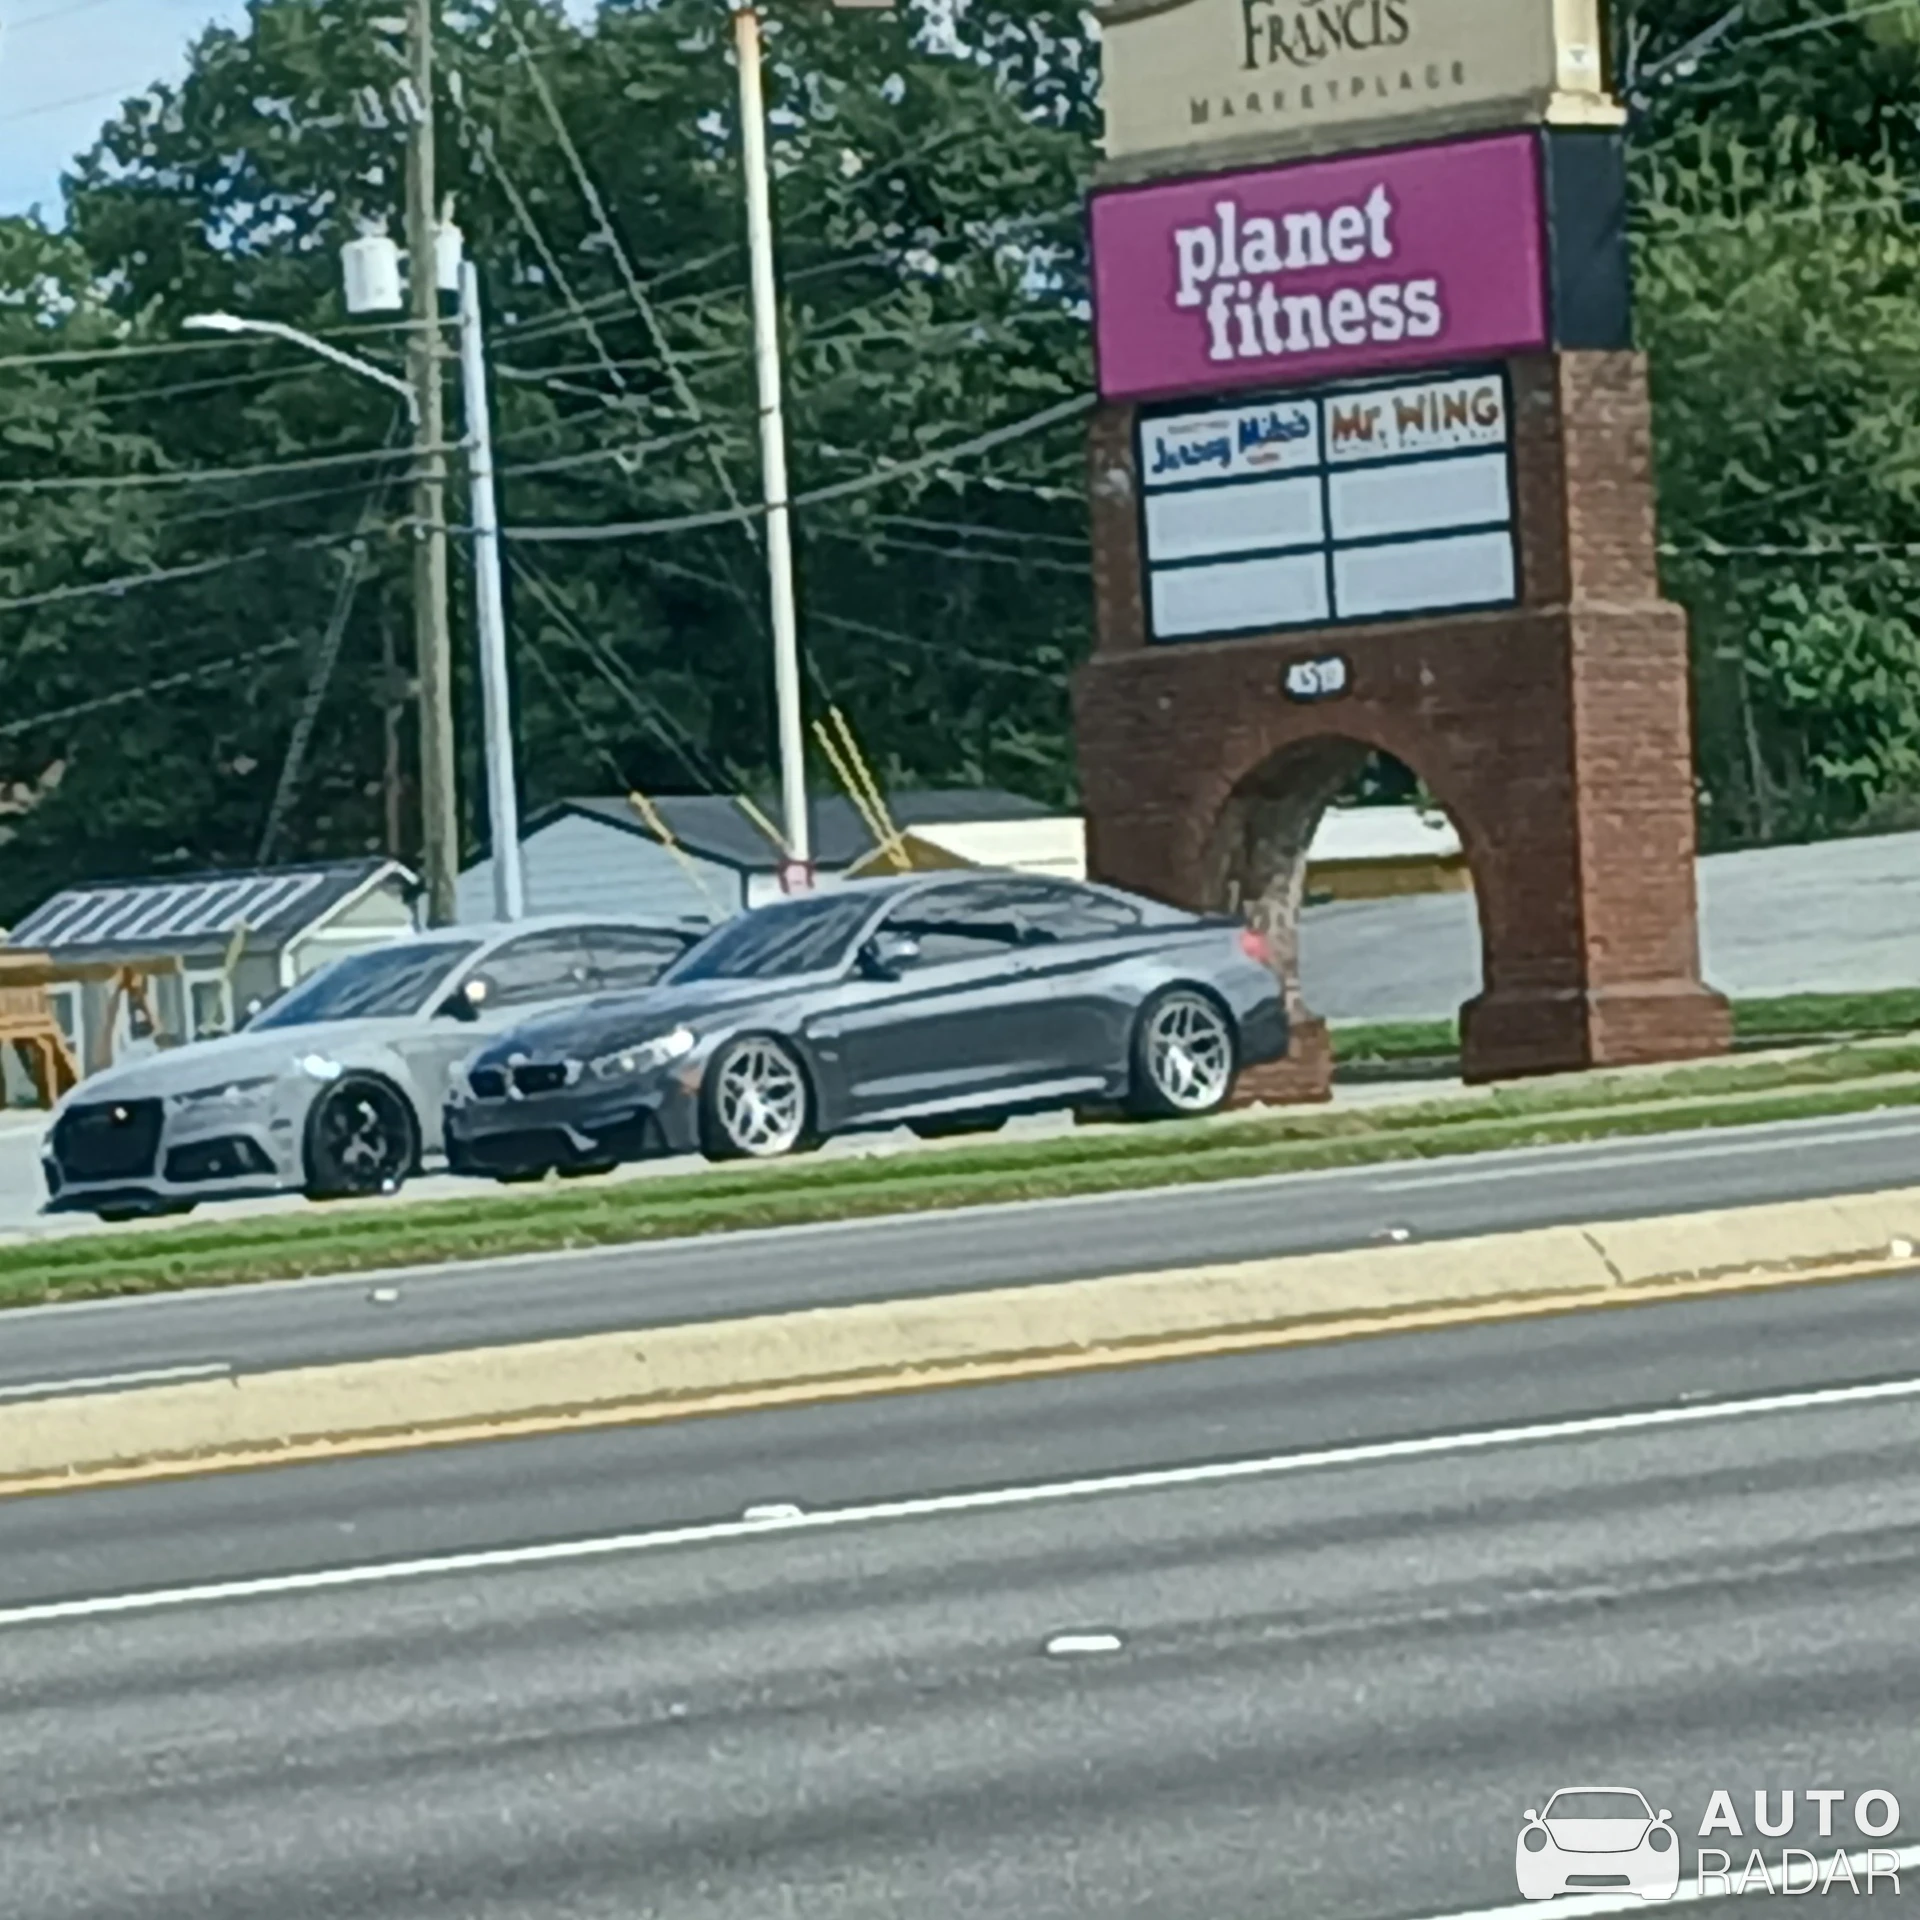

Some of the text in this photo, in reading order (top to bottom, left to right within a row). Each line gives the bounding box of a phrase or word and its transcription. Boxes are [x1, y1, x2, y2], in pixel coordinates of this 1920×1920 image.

[1239, 0, 1409, 70] FRANCIS
[1189, 60, 1464, 125] MARKETPLACE
[1175, 184, 1392, 306] planet
[1207, 278, 1441, 360] fitness
[1332, 403, 1386, 441] Mr.
[1392, 386, 1499, 435] WING
